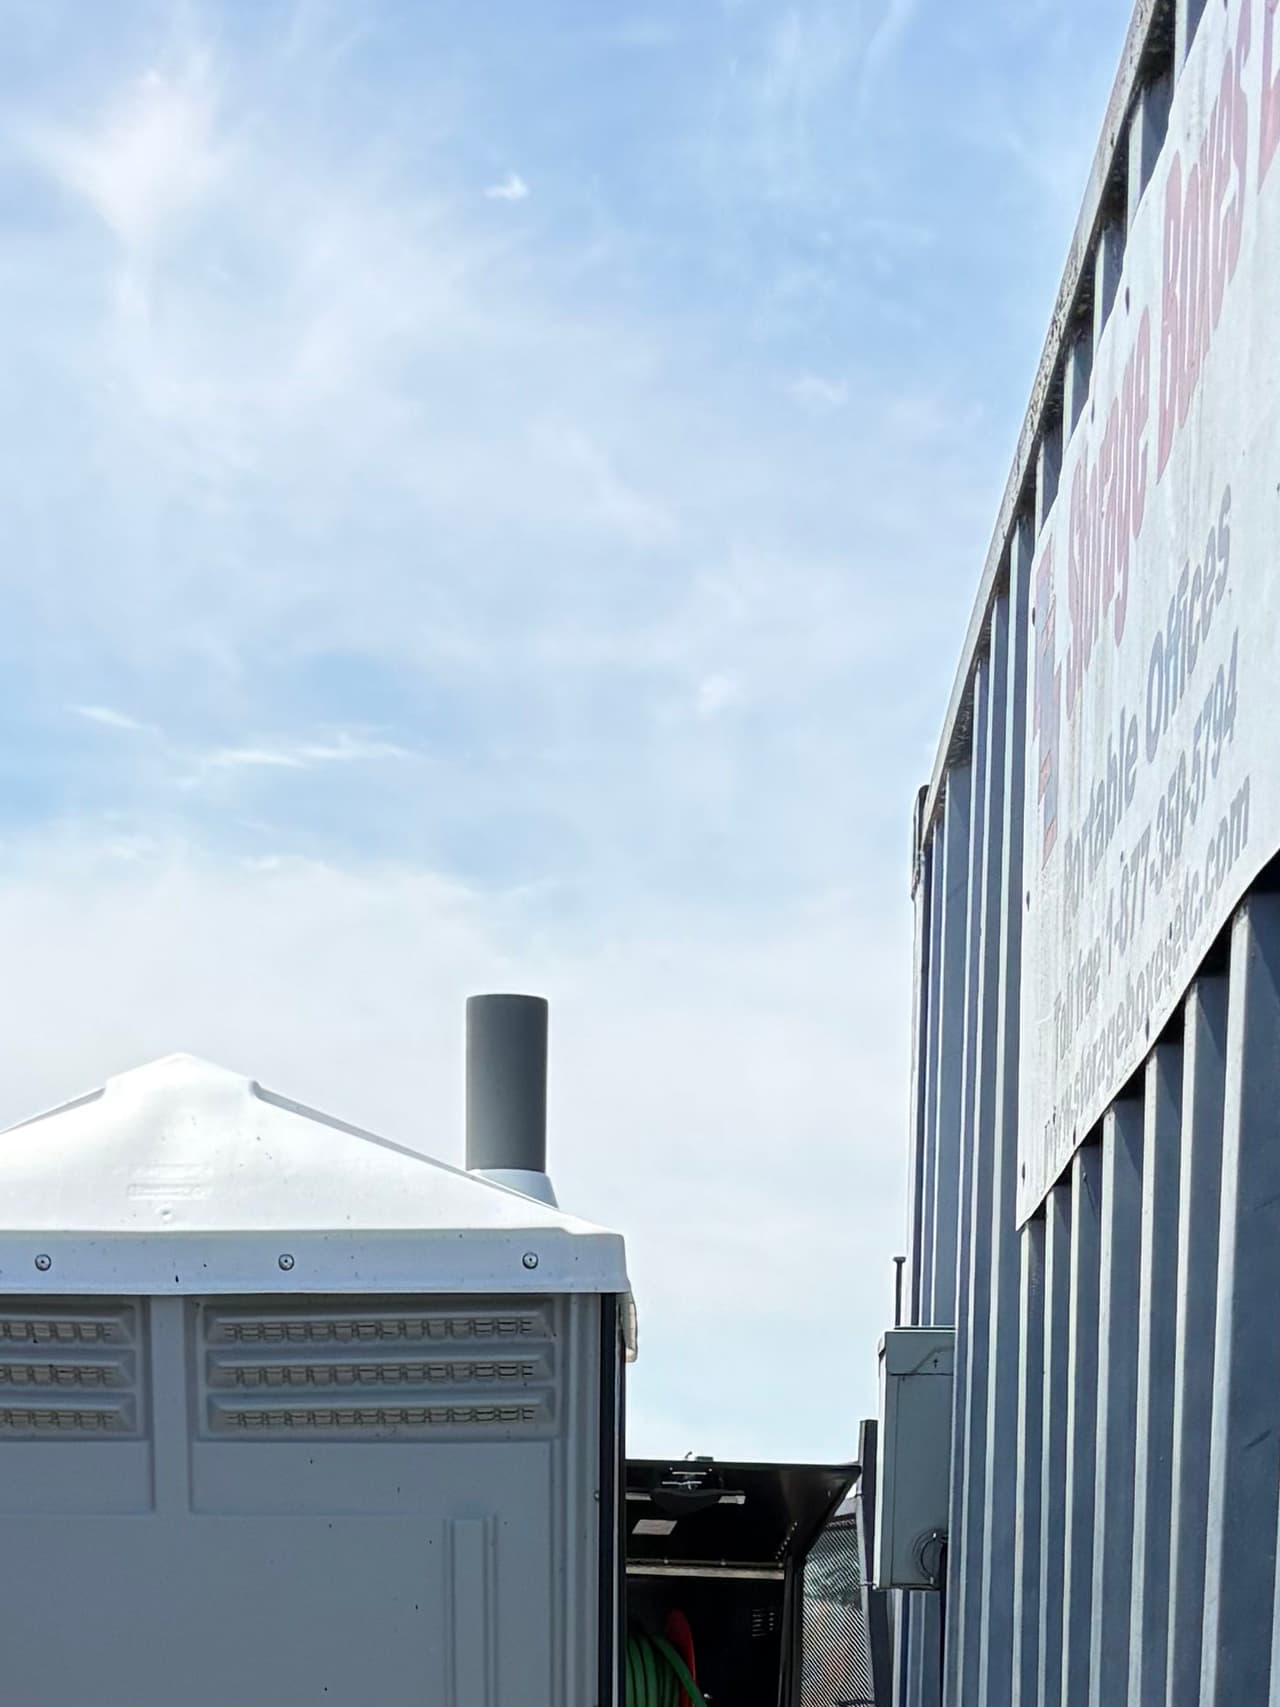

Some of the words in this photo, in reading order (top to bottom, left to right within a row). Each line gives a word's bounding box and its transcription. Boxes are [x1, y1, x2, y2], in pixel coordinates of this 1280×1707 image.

[1066, 304, 1151, 721] Storage
[1157, 0, 1252, 486] Boxes
[1063, 704, 1138, 940] Portable
[1146, 484, 1232, 764] Offices
[1076, 936, 1101, 1031] free
[1106, 626, 1239, 977] 1-877-350-5794
